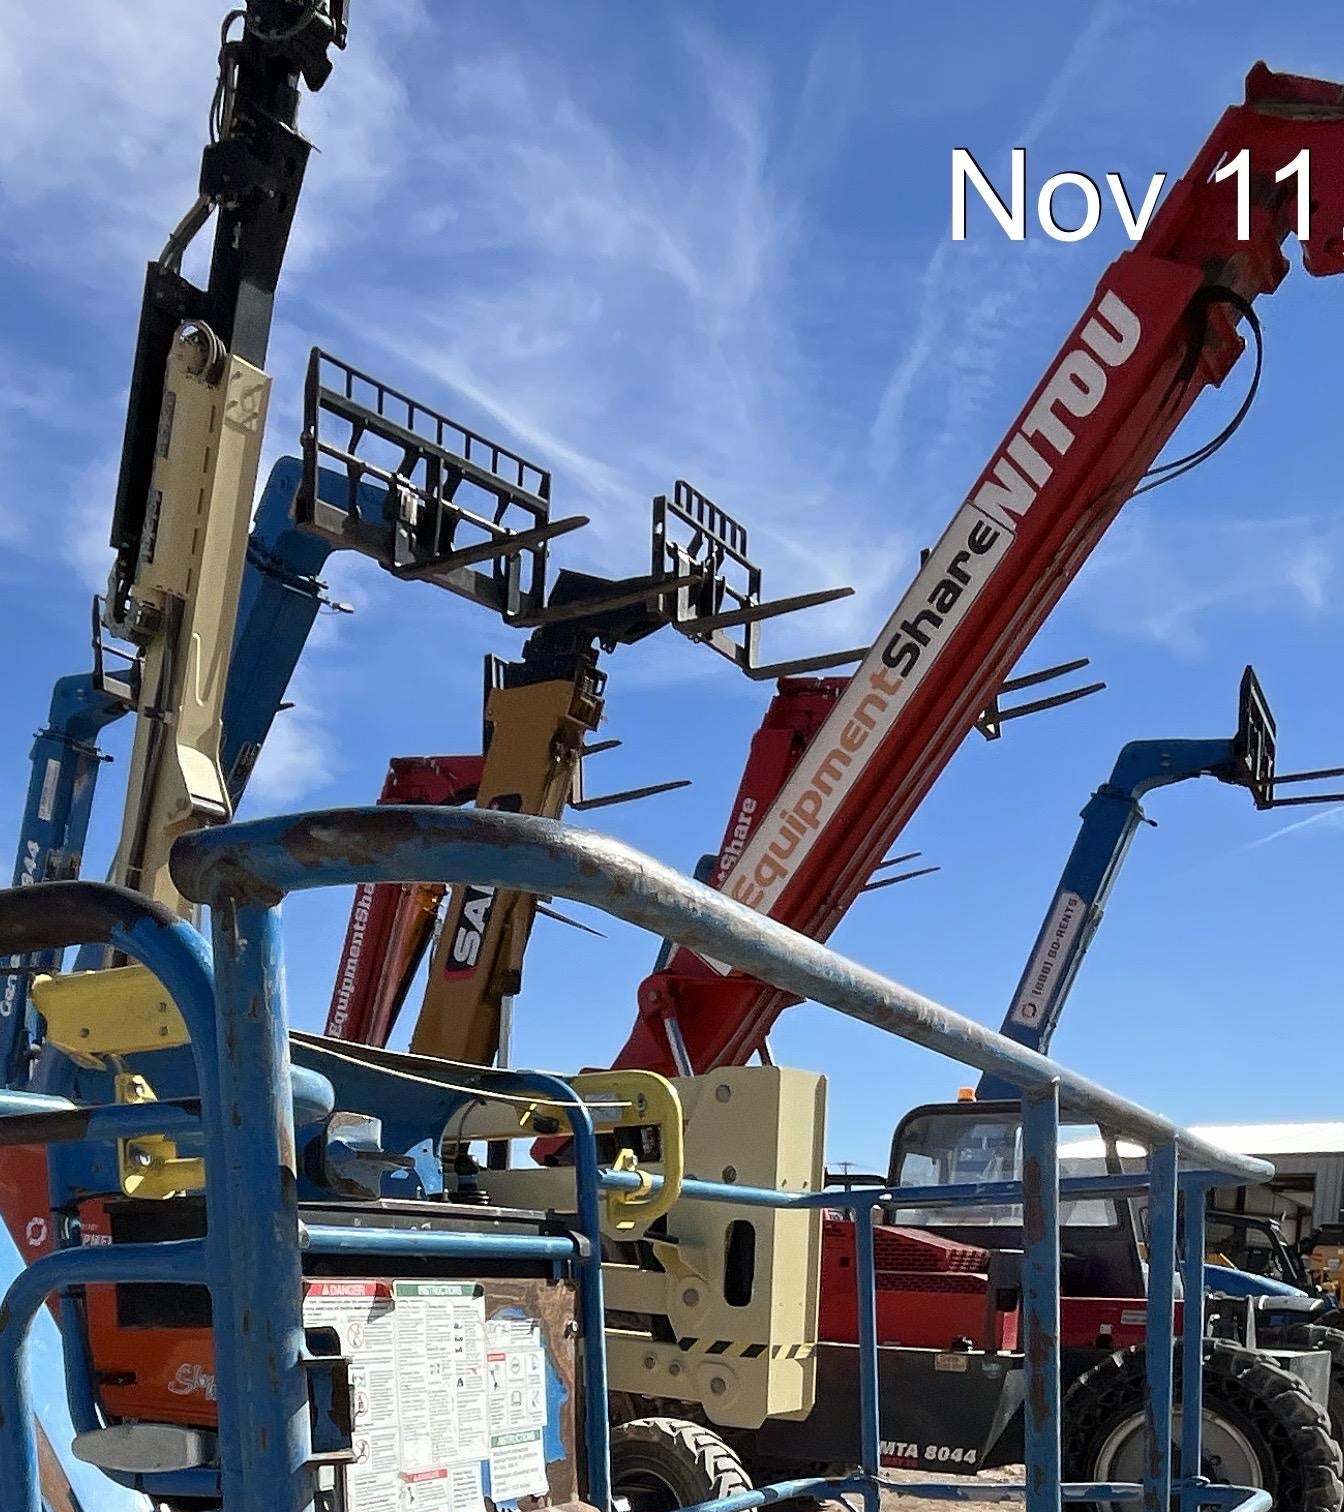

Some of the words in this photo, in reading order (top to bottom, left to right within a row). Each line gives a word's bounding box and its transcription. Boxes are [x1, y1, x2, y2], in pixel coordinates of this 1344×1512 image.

[967, 289, 1143, 524] NITOU
[717, 797, 758, 882] Share
[328, 883, 375, 1038] EquipmentSha
[453, 884, 498, 967] SA
[0, 953, 22, 1017] Gene
[329, 1284, 364, 1297] DANGER
[923, 1444, 977, 1465] 8044
